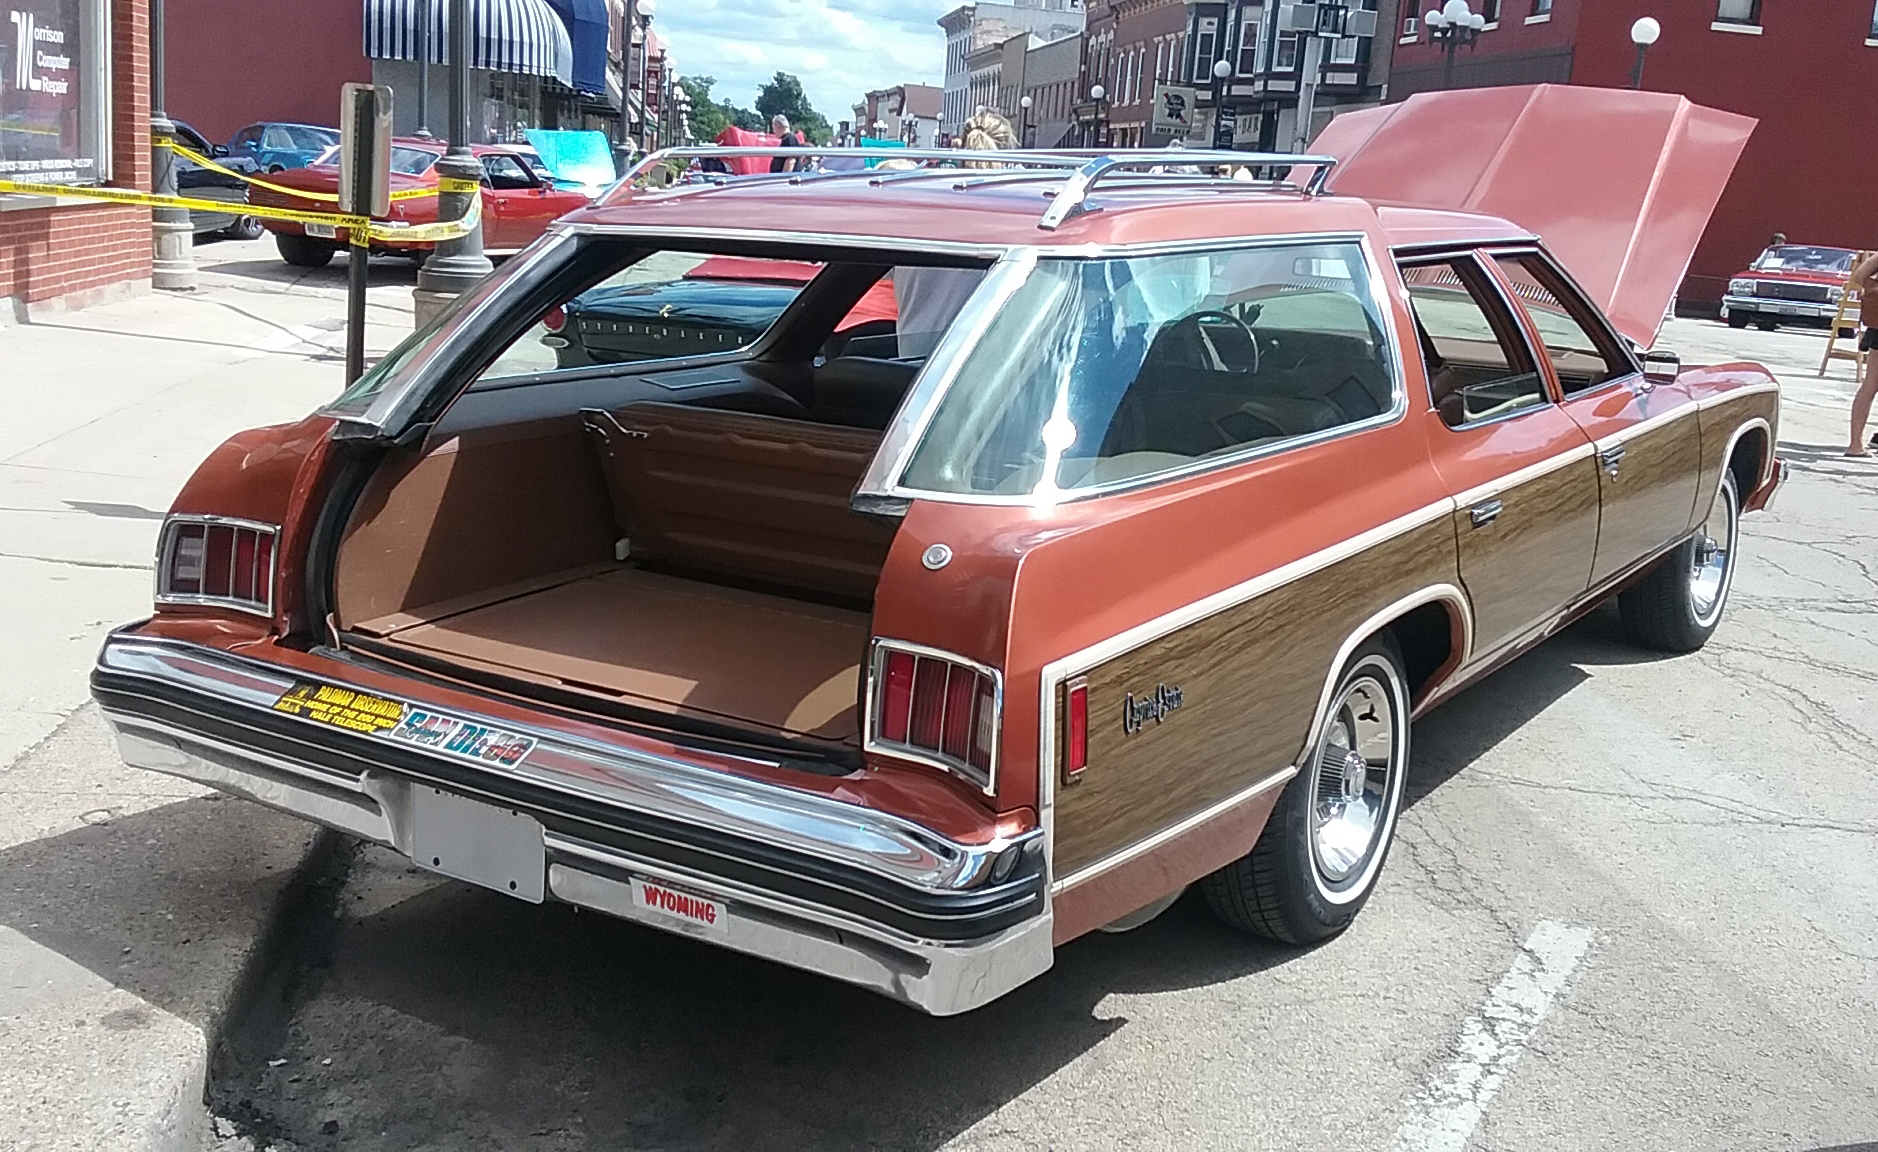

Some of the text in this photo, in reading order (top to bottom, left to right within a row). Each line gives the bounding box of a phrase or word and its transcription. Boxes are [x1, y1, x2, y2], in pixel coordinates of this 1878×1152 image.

[37, 50, 71, 73] Computer
[41, 76, 69, 97] Repair
[1241, 115, 1260, 136] BAR
[314, 685, 356, 706] PALOMAR
[304, 699, 397, 728] HOME OF THE 200 INCH
[309, 710, 377, 733] HALE TELESCOPE
[392, 710, 535, 767] SAN DIEGO
[642, 883, 717, 925] WYOMING
